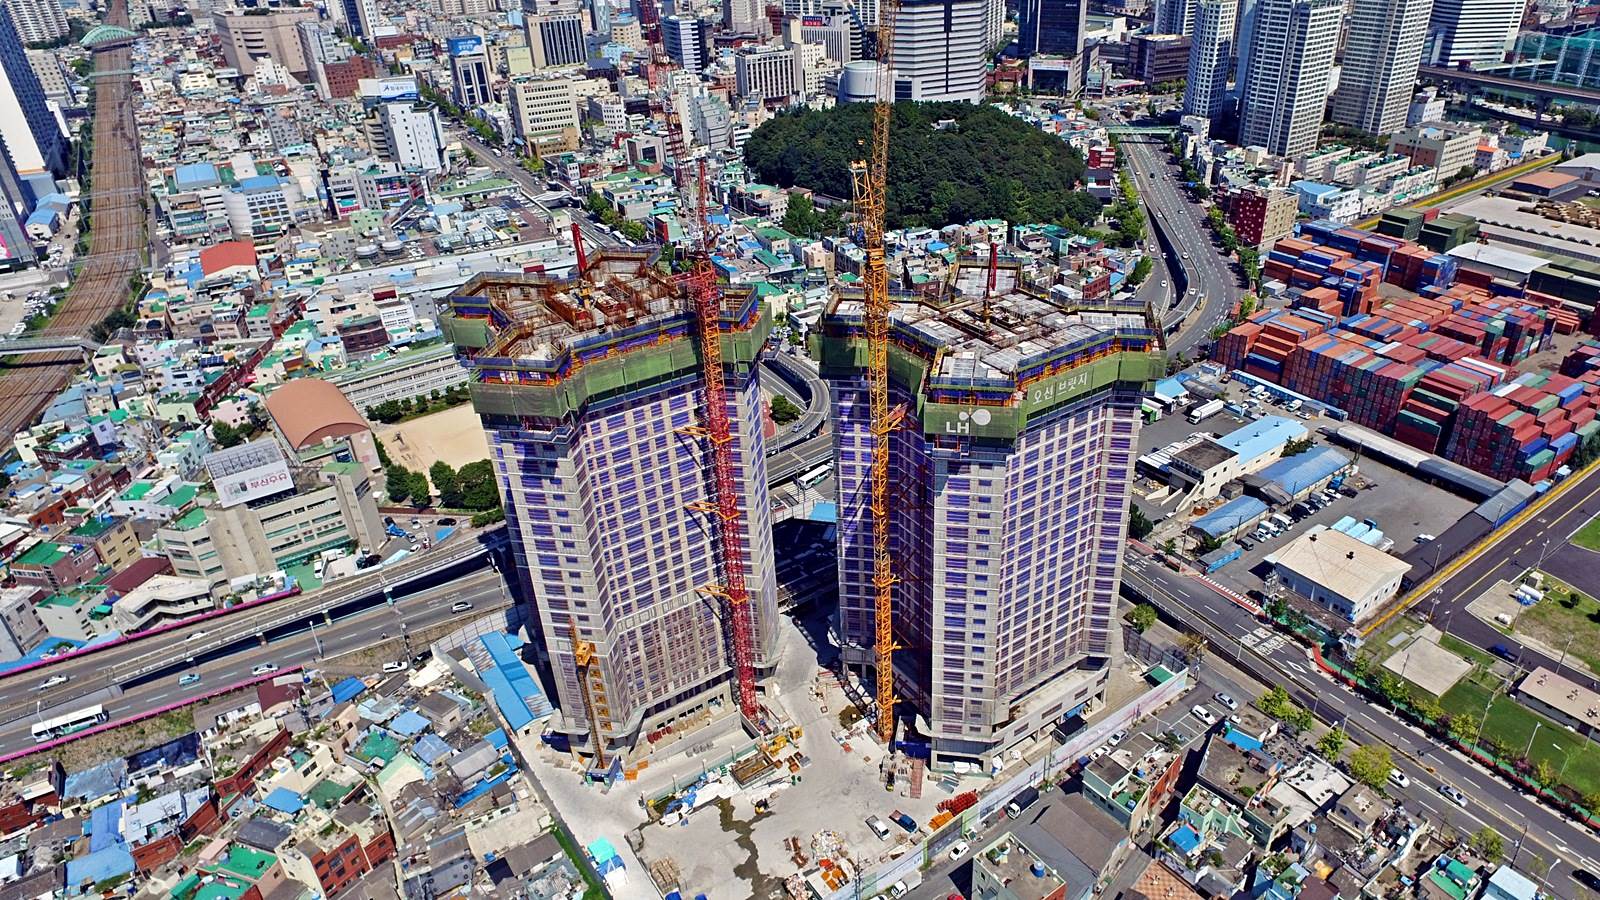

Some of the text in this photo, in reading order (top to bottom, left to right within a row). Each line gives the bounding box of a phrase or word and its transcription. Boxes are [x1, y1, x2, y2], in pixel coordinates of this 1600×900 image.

[1033, 372, 1087, 405] 오션 브릿지
[946, 422, 970, 434] LH
[250, 473, 288, 489] 부산우유
